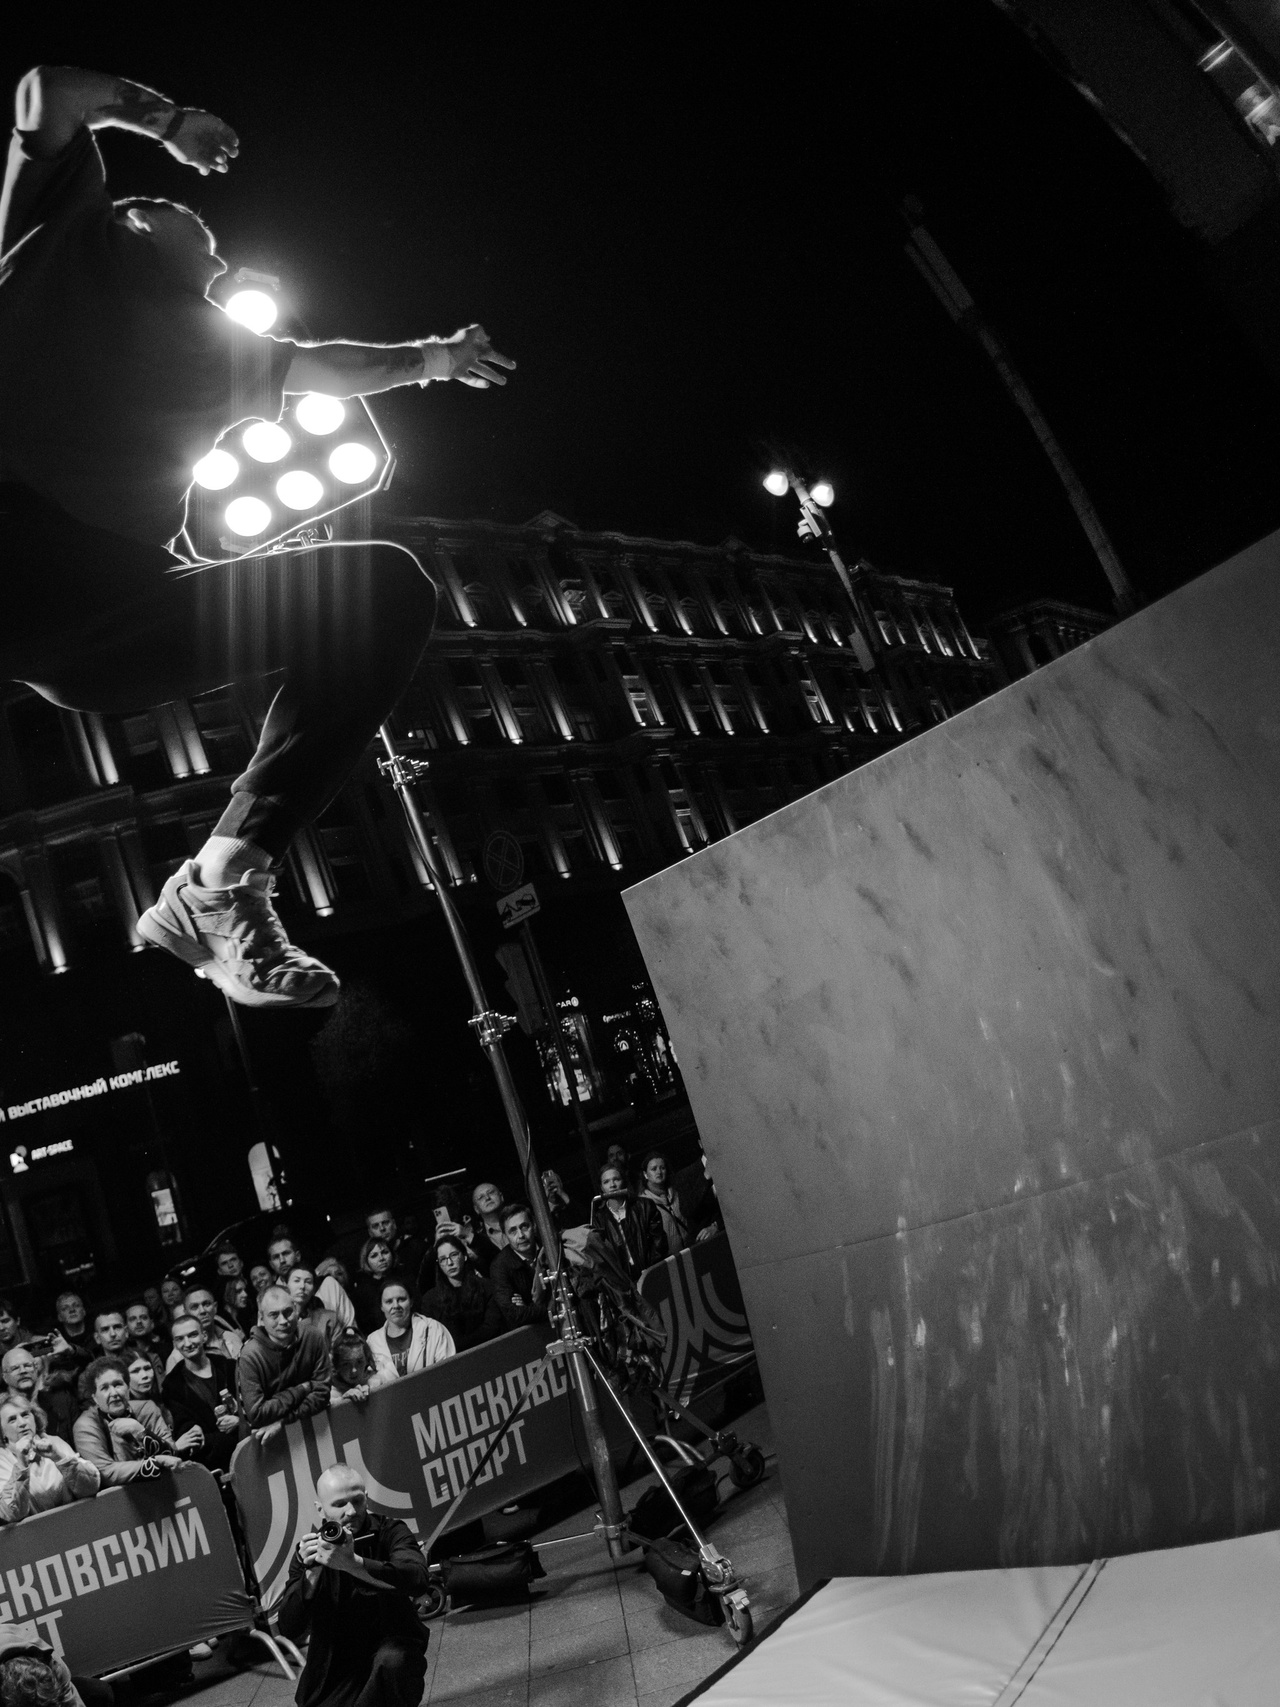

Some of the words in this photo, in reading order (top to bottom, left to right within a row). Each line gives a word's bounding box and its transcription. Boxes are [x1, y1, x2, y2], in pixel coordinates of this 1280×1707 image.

[7, 1077, 108, 1120] ВЫСТАВОЧНЫЙ
[411, 1354, 576, 1460] МОСКОВС
[422, 1419, 527, 1508] СПОРТ
